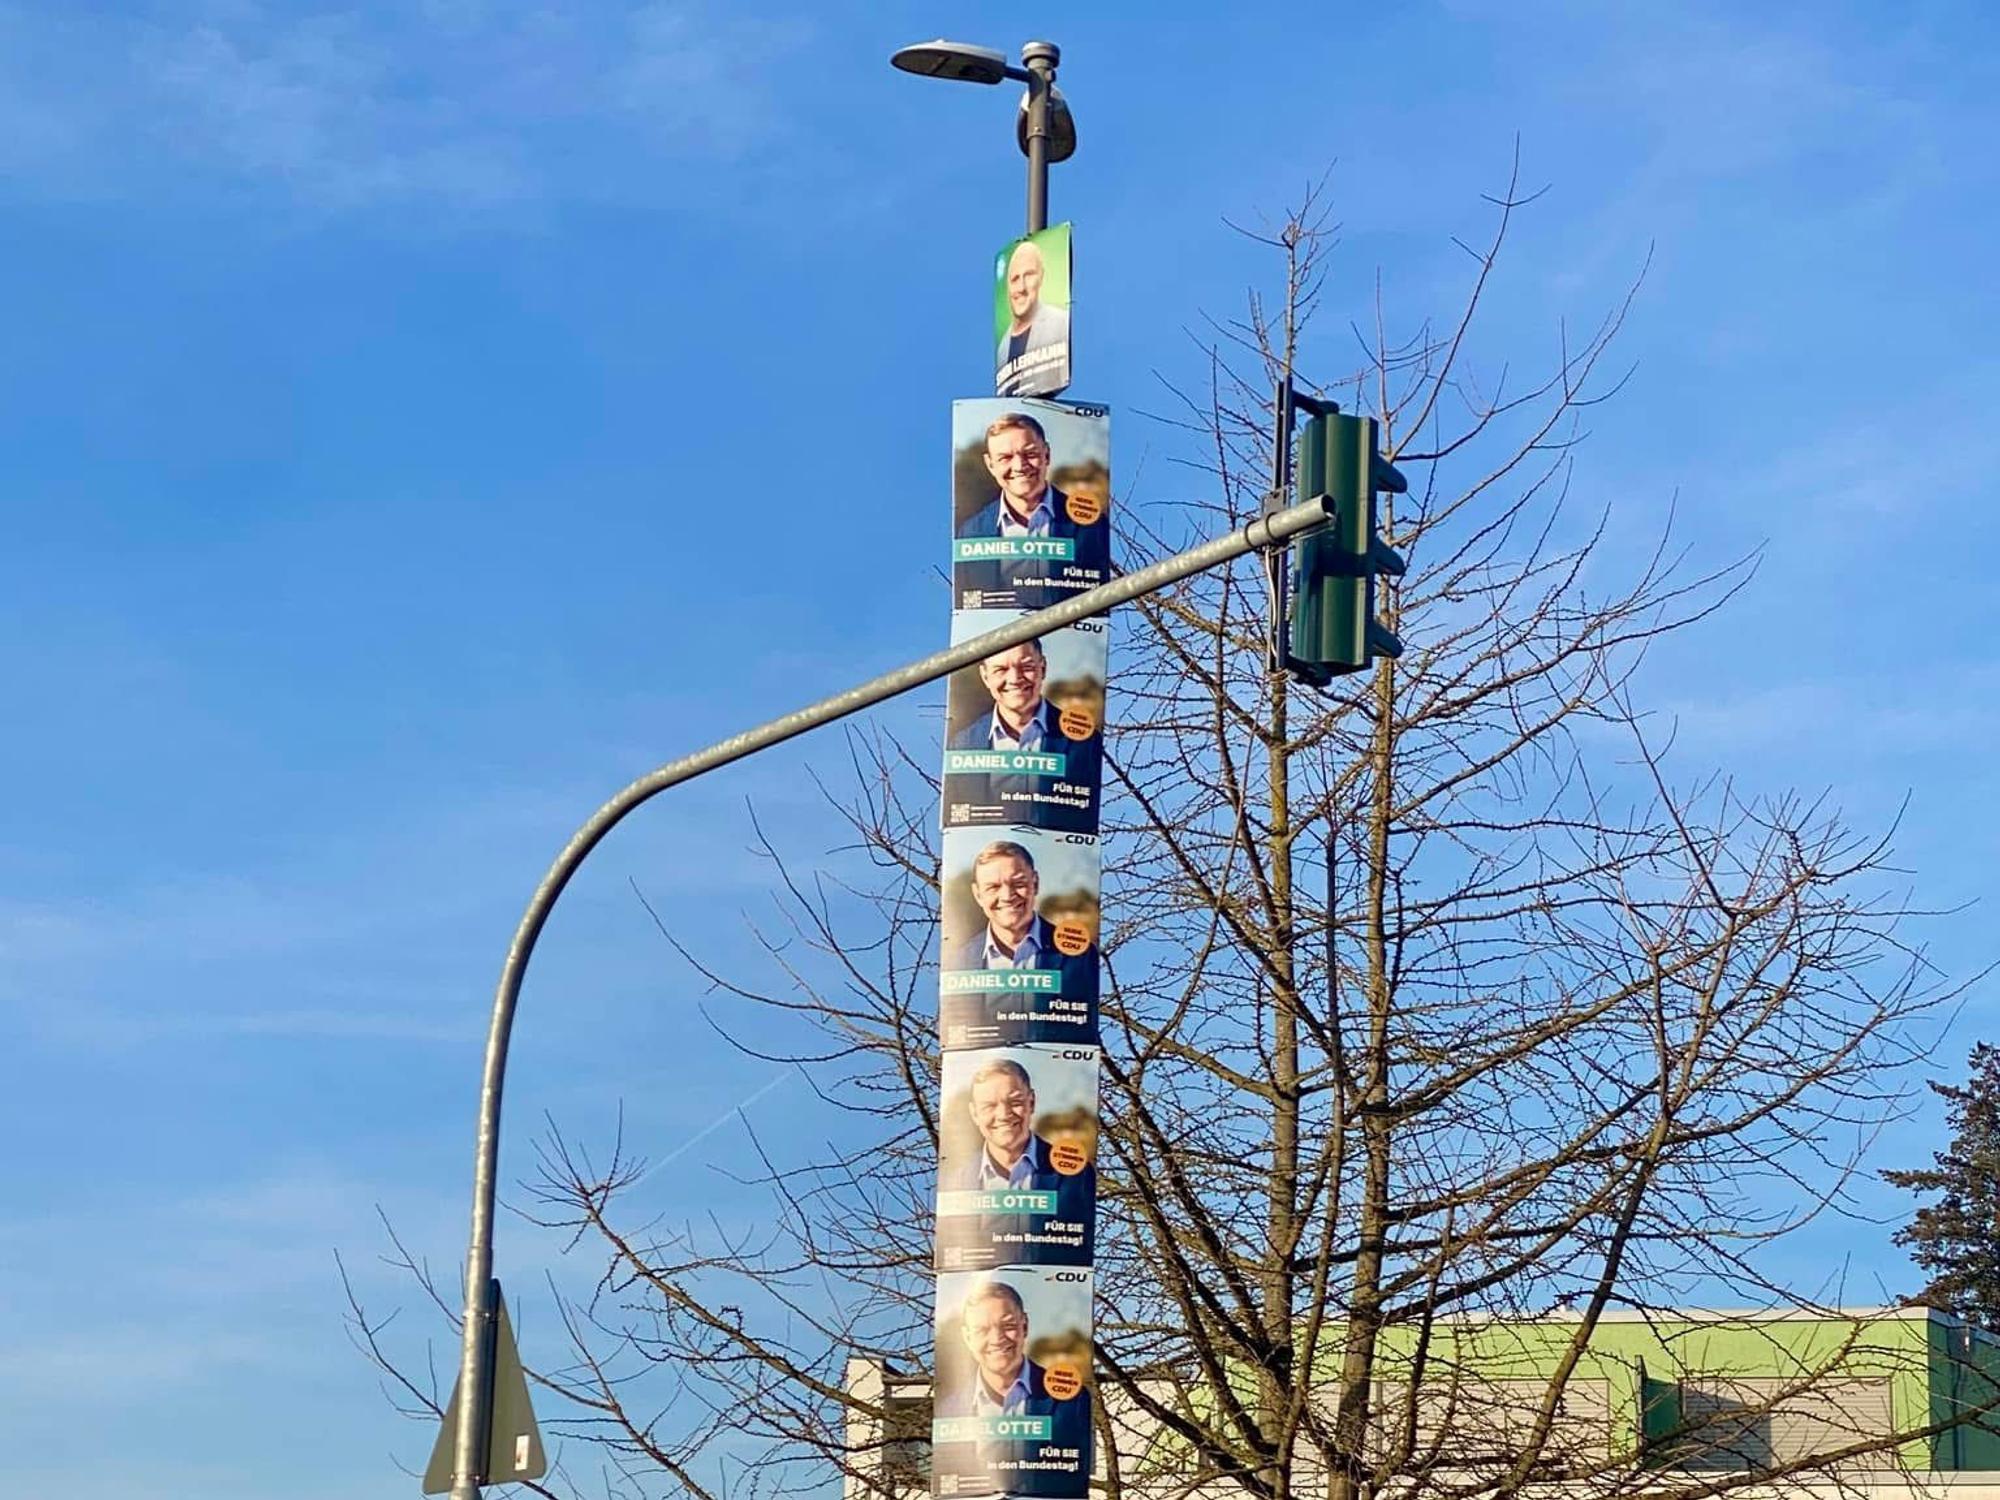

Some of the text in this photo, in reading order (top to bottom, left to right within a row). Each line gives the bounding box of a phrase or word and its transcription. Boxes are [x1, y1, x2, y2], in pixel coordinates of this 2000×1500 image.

[1075, 406, 1104, 417] CDU
[960, 542, 1066, 556] DANIEL OTTE
[1064, 566, 1100, 578] FÜR SIE
[1024, 577, 1043, 586] den
[1074, 621, 1103, 633] CDU
[952, 756, 1057, 771] DANIEL OTTE
[1053, 782, 1091, 796] FÜR SIE
[1012, 792, 1032, 801] den
[1033, 793, 1089, 808] Bundestag!
[1065, 834, 1095, 846] CDU
[948, 975, 1052, 989] DANIEL OTTE
[1049, 999, 1088, 1011] FÜR SIE
[1008, 1012, 1028, 1021] den
[1029, 1012, 1087, 1024] Bundestag!
[1062, 1050, 1094, 1061] CDU
[1003, 1195, 1048, 1208] OTTE
[1044, 1220, 1084, 1233] FÜR SIE
[1004, 1233, 1022, 1242] den
[1024, 1234, 1083, 1246] Bundestag!
[1056, 1272, 1087, 1282] CDU
[998, 1421, 1043, 1434] OTTE
[1039, 1446, 1080, 1458] FÜR SIE
[999, 1461, 1018, 1470] den
[1020, 1461, 1078, 1472] Bundestag!
